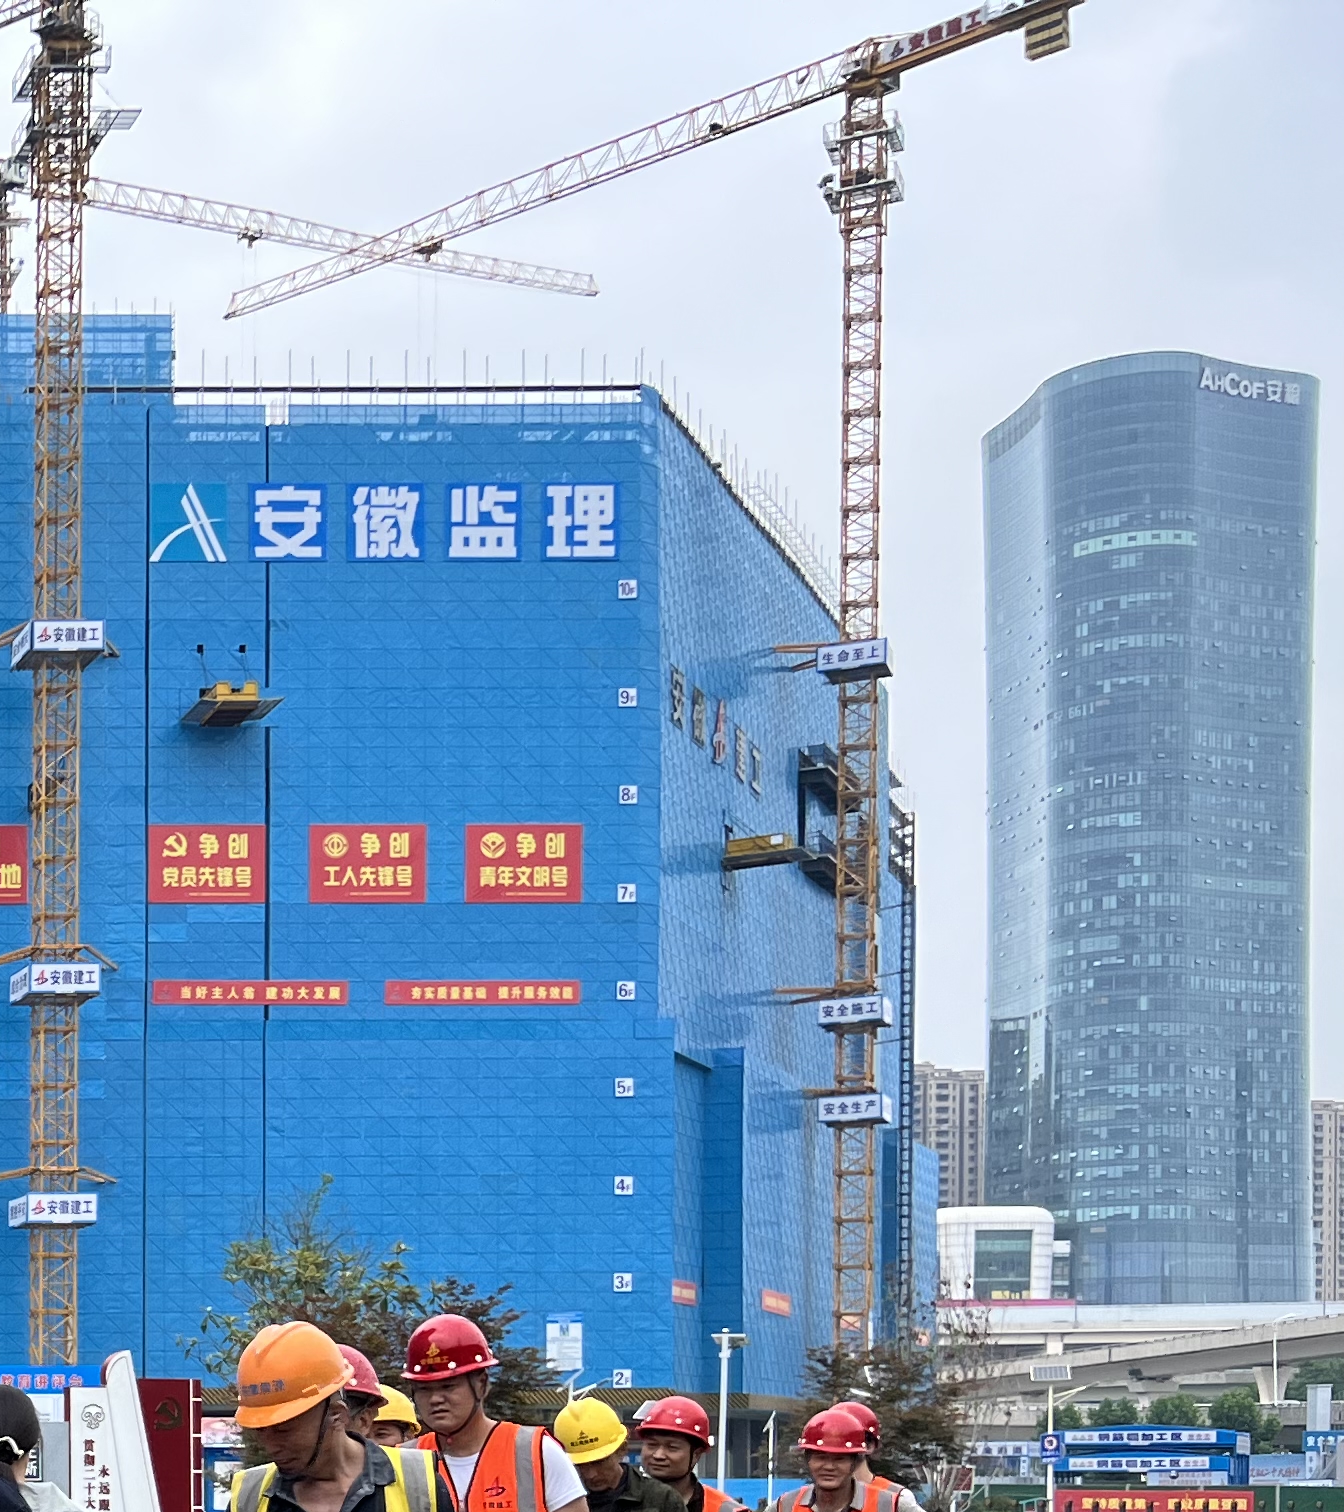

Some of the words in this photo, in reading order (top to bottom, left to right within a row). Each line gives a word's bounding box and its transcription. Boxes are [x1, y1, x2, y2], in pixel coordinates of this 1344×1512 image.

[1199, 366, 1265, 399] AHCOF
[253, 485, 617, 560] 安徽监理
[619, 582, 636, 597] 10F
[53, 626, 100, 642] 安徽建工
[821, 645, 880, 666] 生命至上
[619, 690, 637, 705] 9F
[620, 787, 637, 802] 8F
[199, 832, 250, 859] 争创
[360, 832, 411, 859] 争创
[516, 832, 566, 859] 争创
[161, 865, 252, 888] 党员先锋号
[322, 865, 414, 888] 工人先锋号
[479, 865, 569, 888] 青年文明号
[619, 886, 636, 901] 7F
[50, 969, 97, 986] 安徽建工
[617, 983, 634, 998] 6F
[821, 1001, 879, 1018] 安全施工
[616, 1079, 632, 1095] 5F
[822, 1099, 878, 1116] 安全生产
[615, 1178, 632, 1193] 4F
[46, 1200, 94, 1215] 安徽建工
[614, 1275, 631, 1290] 3F
[614, 1371, 631, 1386] 2F
